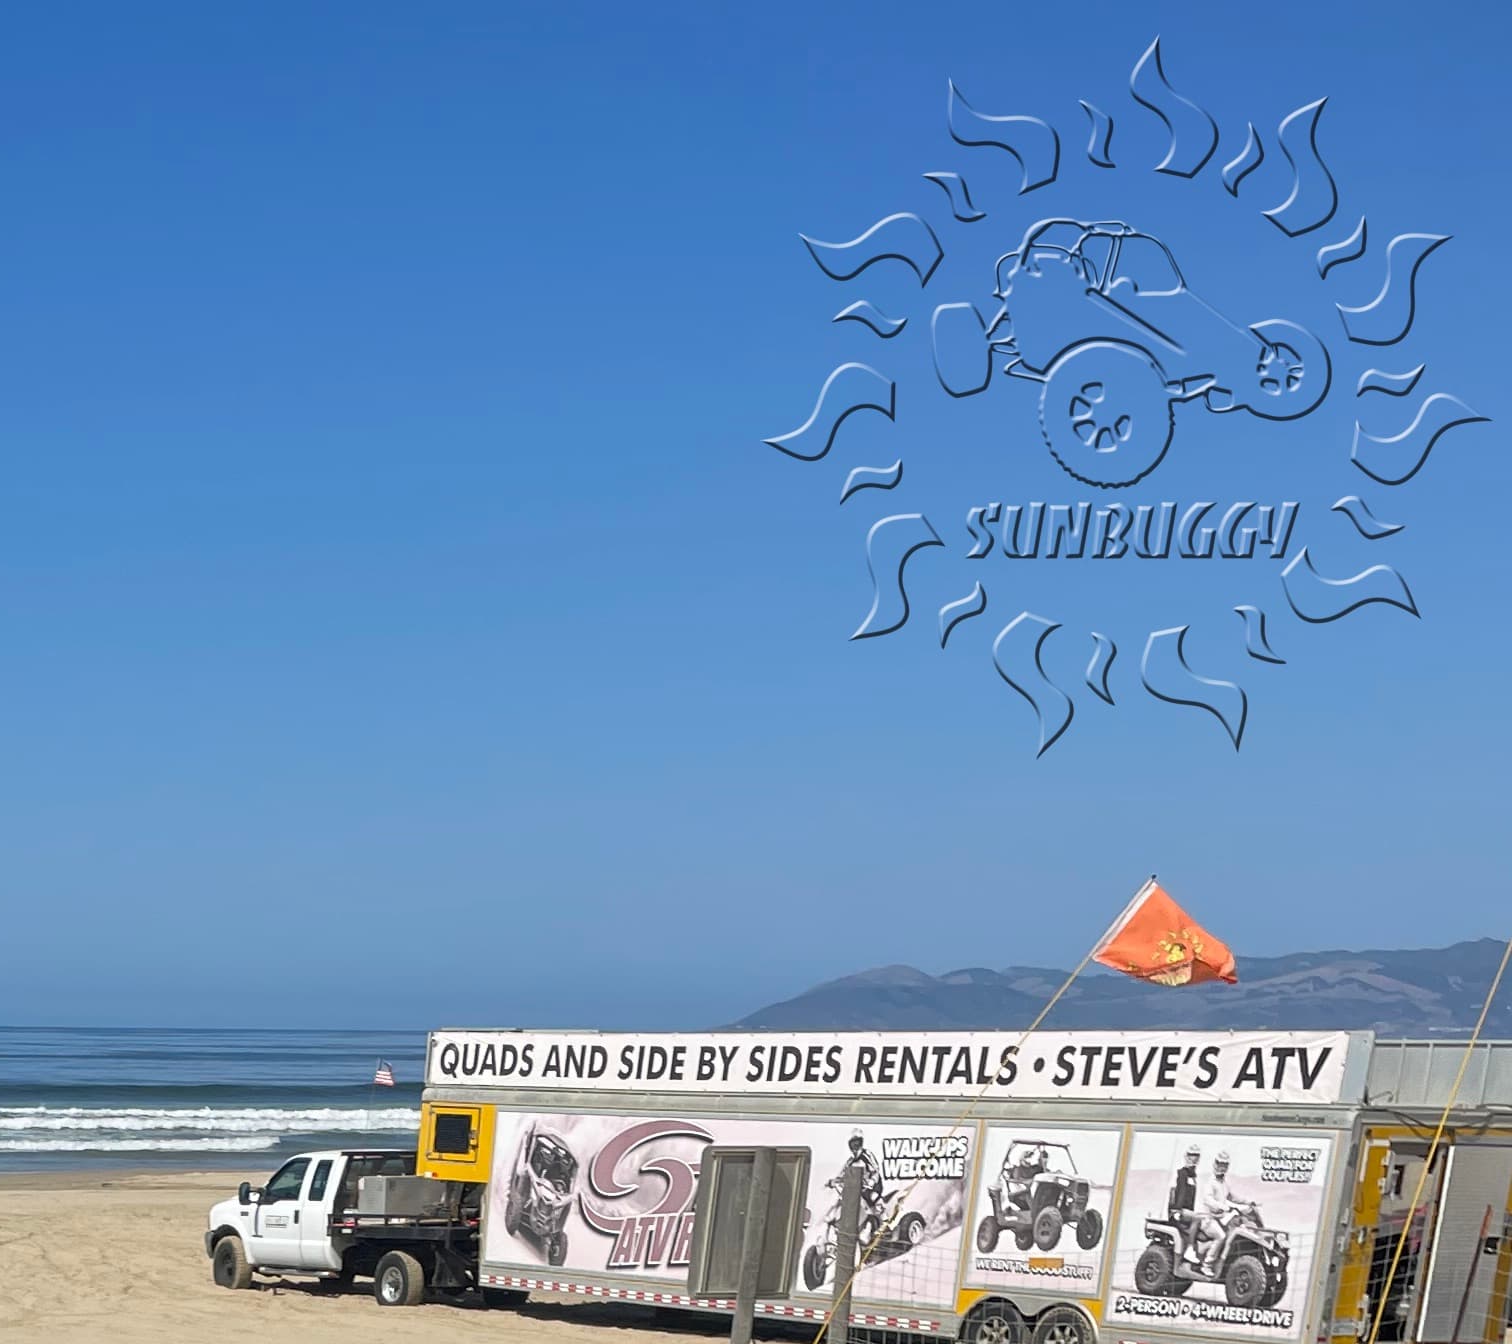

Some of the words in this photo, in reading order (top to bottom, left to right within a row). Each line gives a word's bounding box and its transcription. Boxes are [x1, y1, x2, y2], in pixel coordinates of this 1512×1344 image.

[440, 1042, 534, 1079] QUADS
[541, 1044, 609, 1079] AND
[617, 1045, 687, 1081] SIDE
[696, 1045, 740, 1082] BY
[745, 1045, 844, 1084] SIDES
[854, 1045, 1021, 1086] RENTALS
[1052, 1045, 1221, 1089] STEVE'S
[1232, 1046, 1334, 1090] ATV
[882, 1135, 969, 1159] WALK-UPS
[882, 1157, 966, 1181] WELCOME
[606, 1214, 680, 1268] ATV
[1115, 1296, 1181, 1318] 2-PERSON
[1251, 1307, 1294, 1329] DRIVE
